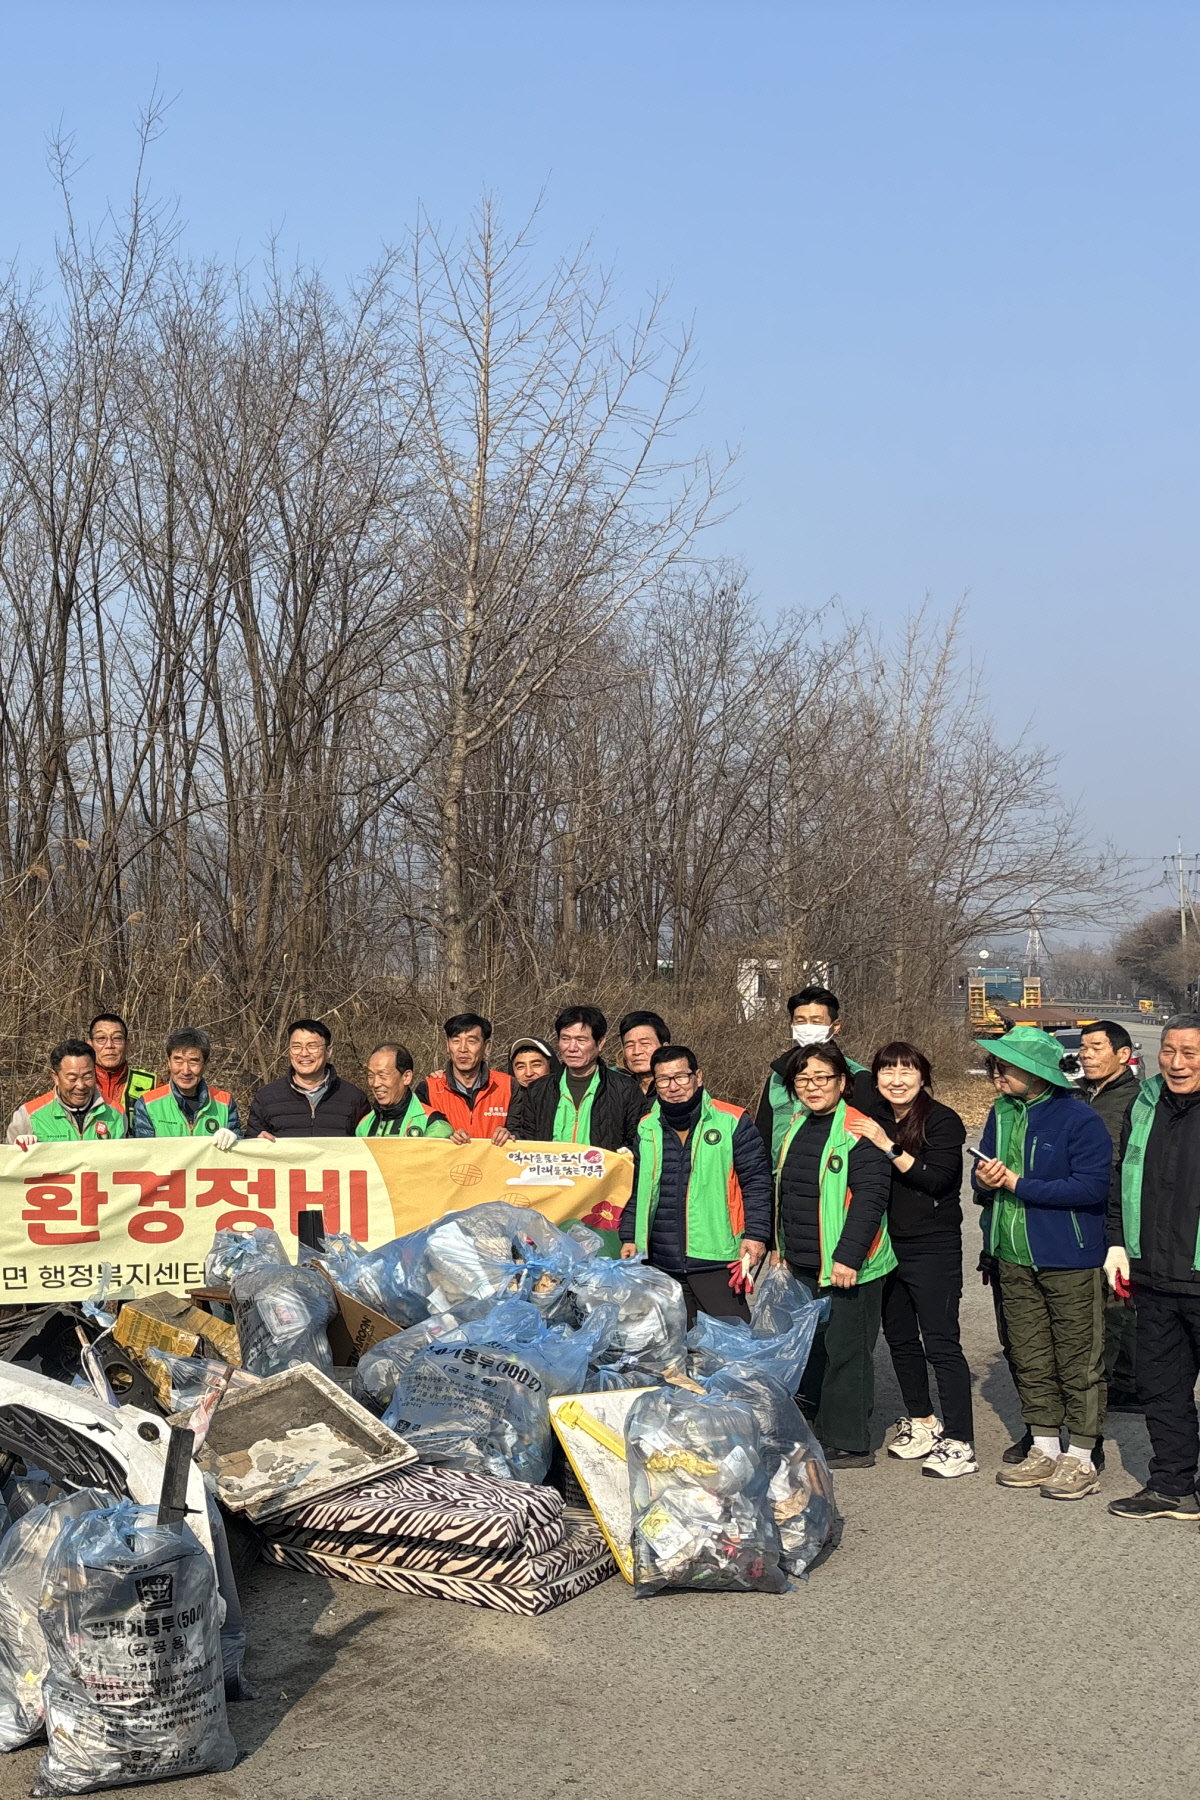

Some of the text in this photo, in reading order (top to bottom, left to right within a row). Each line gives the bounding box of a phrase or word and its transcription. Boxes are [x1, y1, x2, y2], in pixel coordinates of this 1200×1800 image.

[508, 1152, 542, 1165] 역사를
[561, 1153, 582, 1164] 도시
[529, 1165, 561, 1176] 미래를
[581, 1165, 604, 1178] 경주
[21, 1168, 369, 1246] 환경정비
[39, 1261, 206, 1290] 행정복지센터
